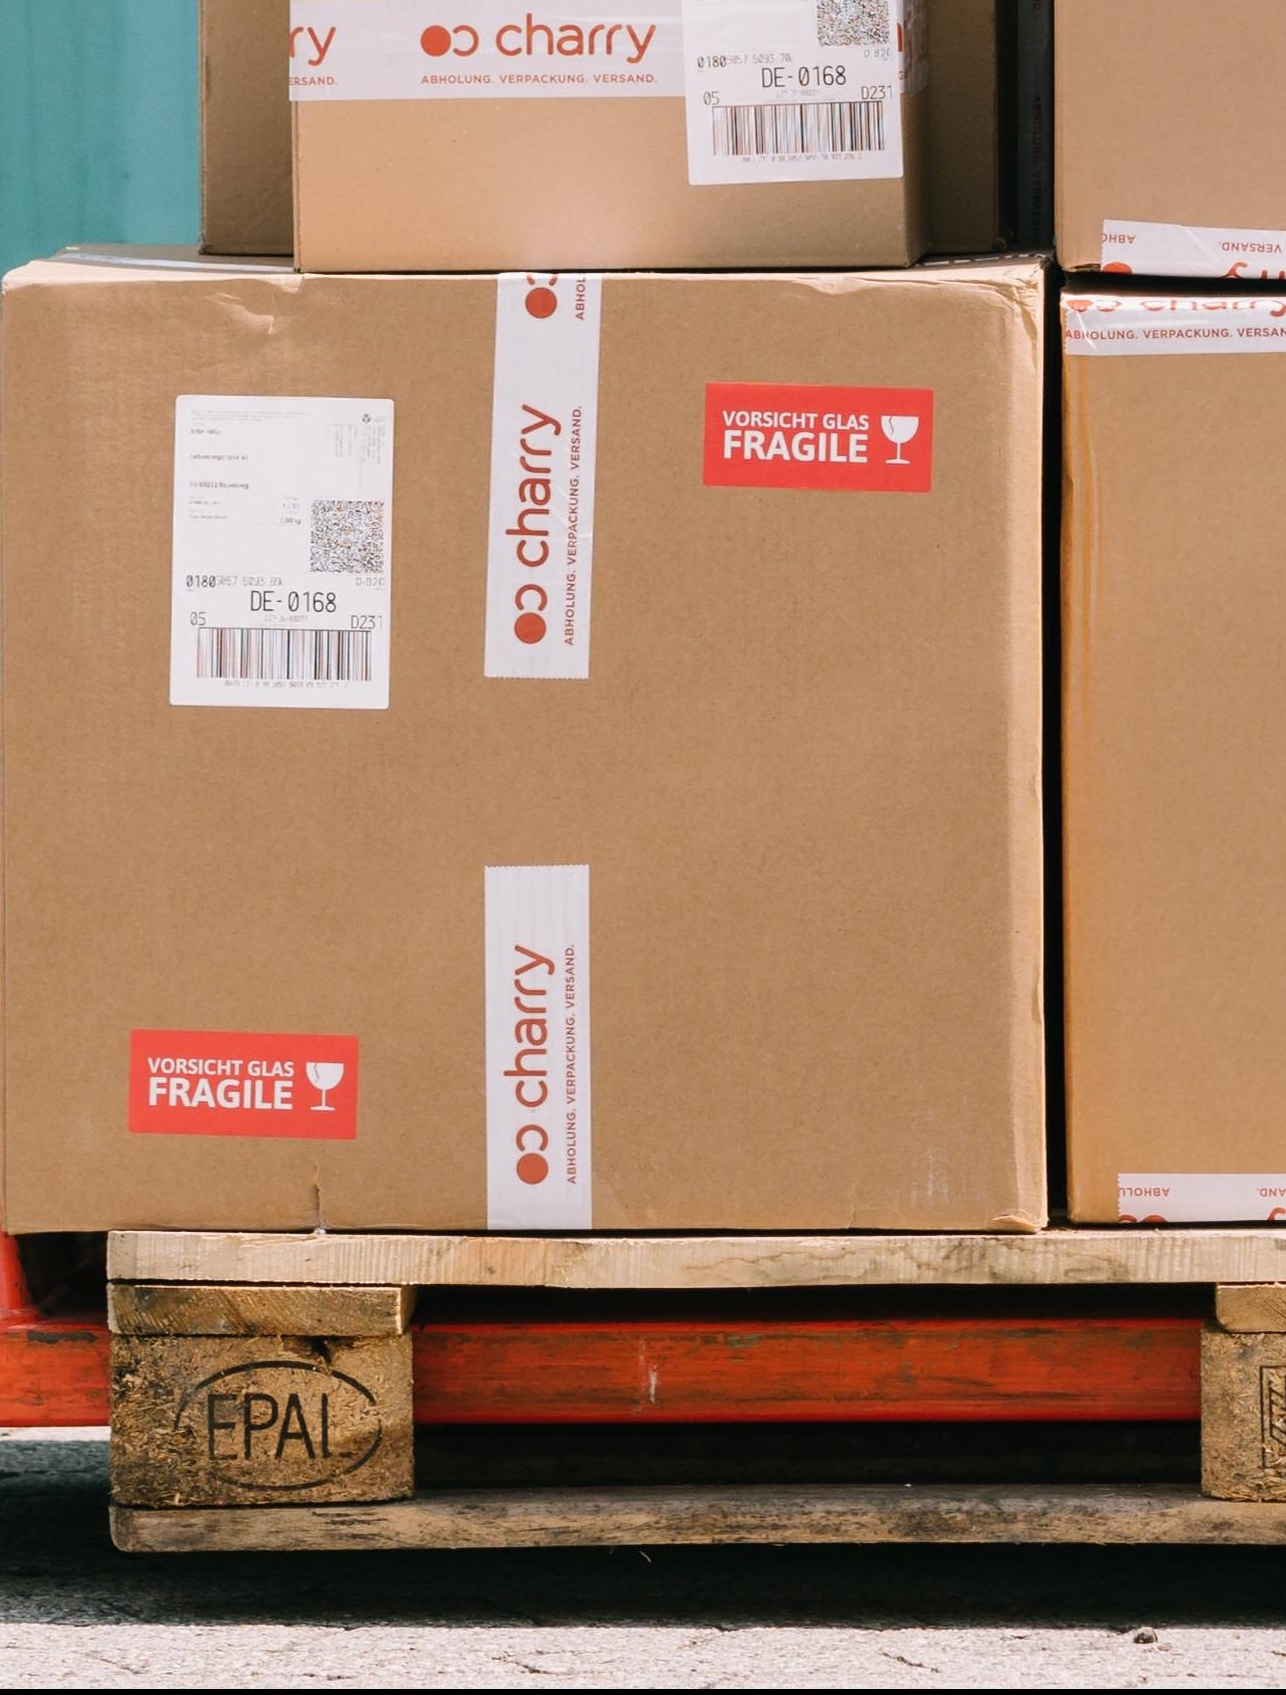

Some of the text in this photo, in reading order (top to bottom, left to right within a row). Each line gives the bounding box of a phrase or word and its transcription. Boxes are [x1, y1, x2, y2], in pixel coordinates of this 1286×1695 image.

[495, 13, 657, 65] charry
[420, 73, 659, 85] ABHOLUNG. VERPACKUNG. VERSAND.
[761, 65, 847, 88] DE-0168
[703, 91, 720, 105] 05
[1218, 241, 1282, 254] VERSAND.
[1065, 328, 1139, 340] ABHOLUNG.
[1143, 328, 1234, 340] VERPACKUNG.
[722, 410, 869, 430] VORSICHT GLAS
[723, 429, 868, 463] FRAGILE
[505, 404, 562, 568] charry
[564, 405, 582, 646] ABHOLUNG. VERPACKUNG. VERSAND.
[250, 590, 337, 613] DE-0168
[190, 611, 206, 625] 05
[503, 944, 555, 1108] charry
[147, 1057, 294, 1077] VORSICHT GLAS
[565, 944, 577, 1185] ABHOLUNG. VERPACKUNG. VERSAND.
[148, 1077, 293, 1110] FRAGILE
[207, 1392, 356, 1460] EPAL
